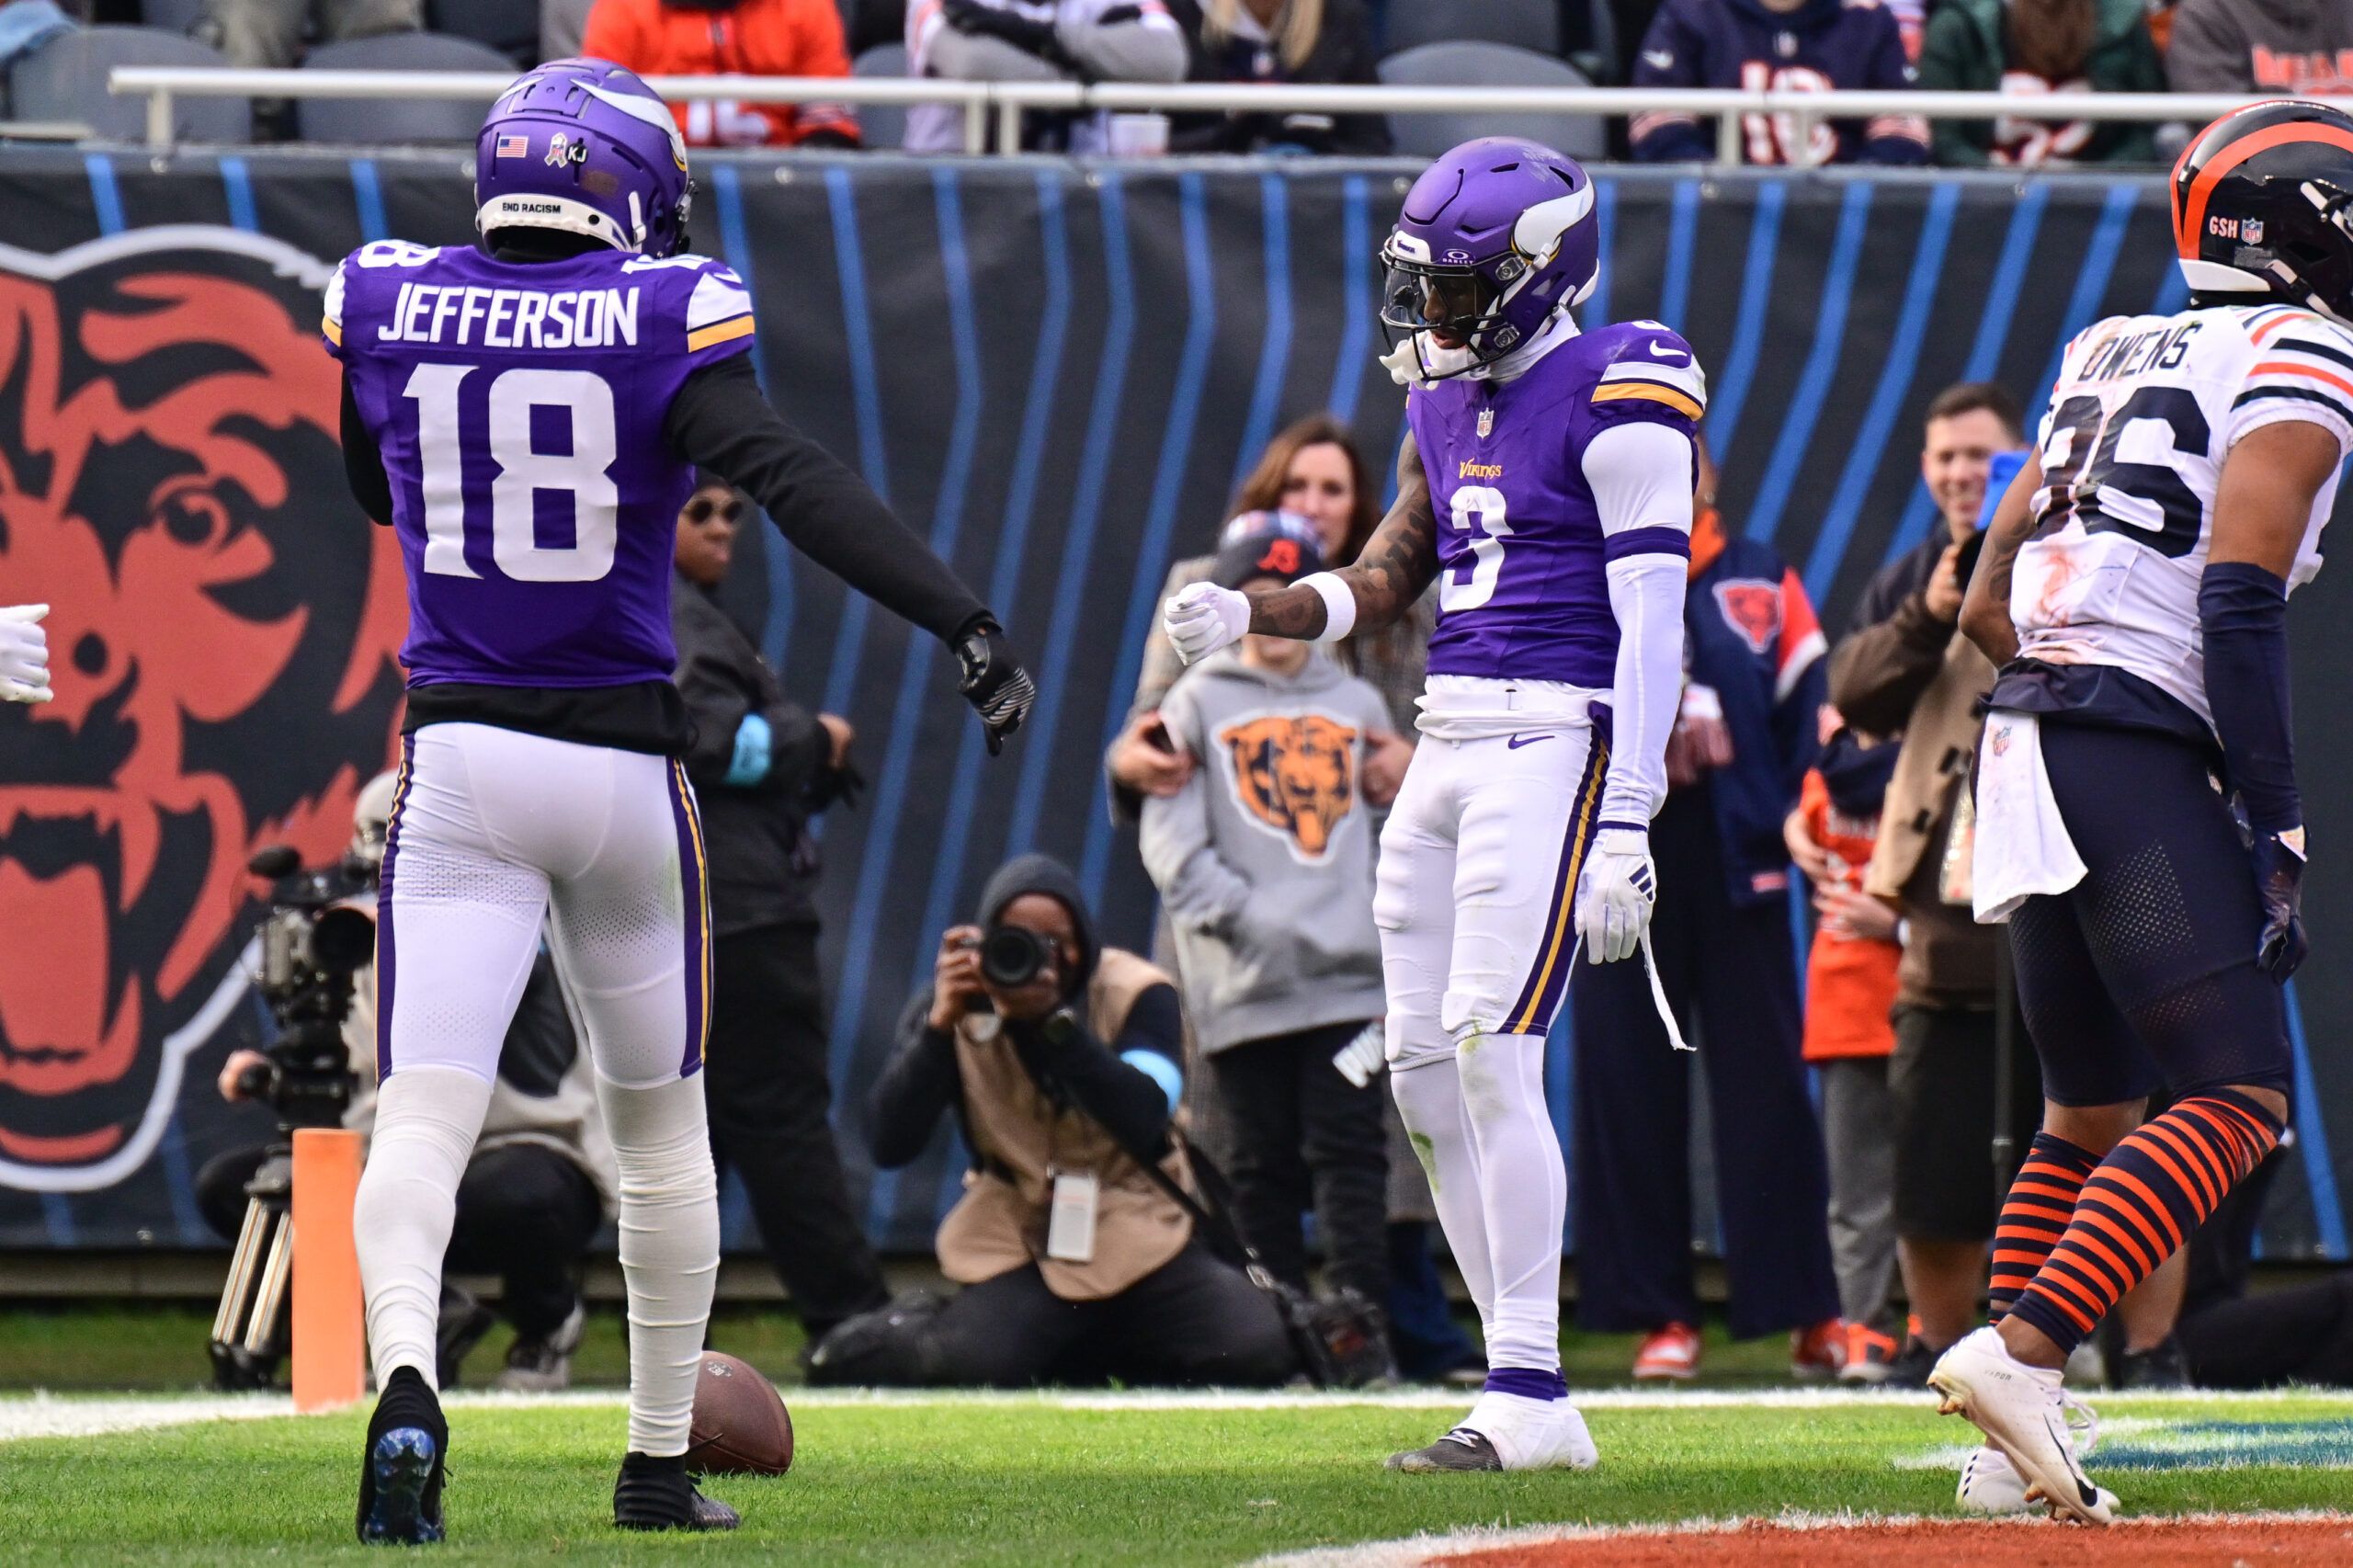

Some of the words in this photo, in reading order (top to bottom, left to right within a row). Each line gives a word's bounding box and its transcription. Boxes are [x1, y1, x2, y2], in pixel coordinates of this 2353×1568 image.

[568, 147, 586, 162] KJ
[503, 202, 519, 212] END
[522, 203, 561, 213] RACISM
[2209, 216, 2238, 238] GSH
[379, 282, 640, 348] JEFFERSON
[2077, 320, 2204, 381] OWENS
[402, 362, 619, 583] 18
[1439, 485, 1514, 612] 3
